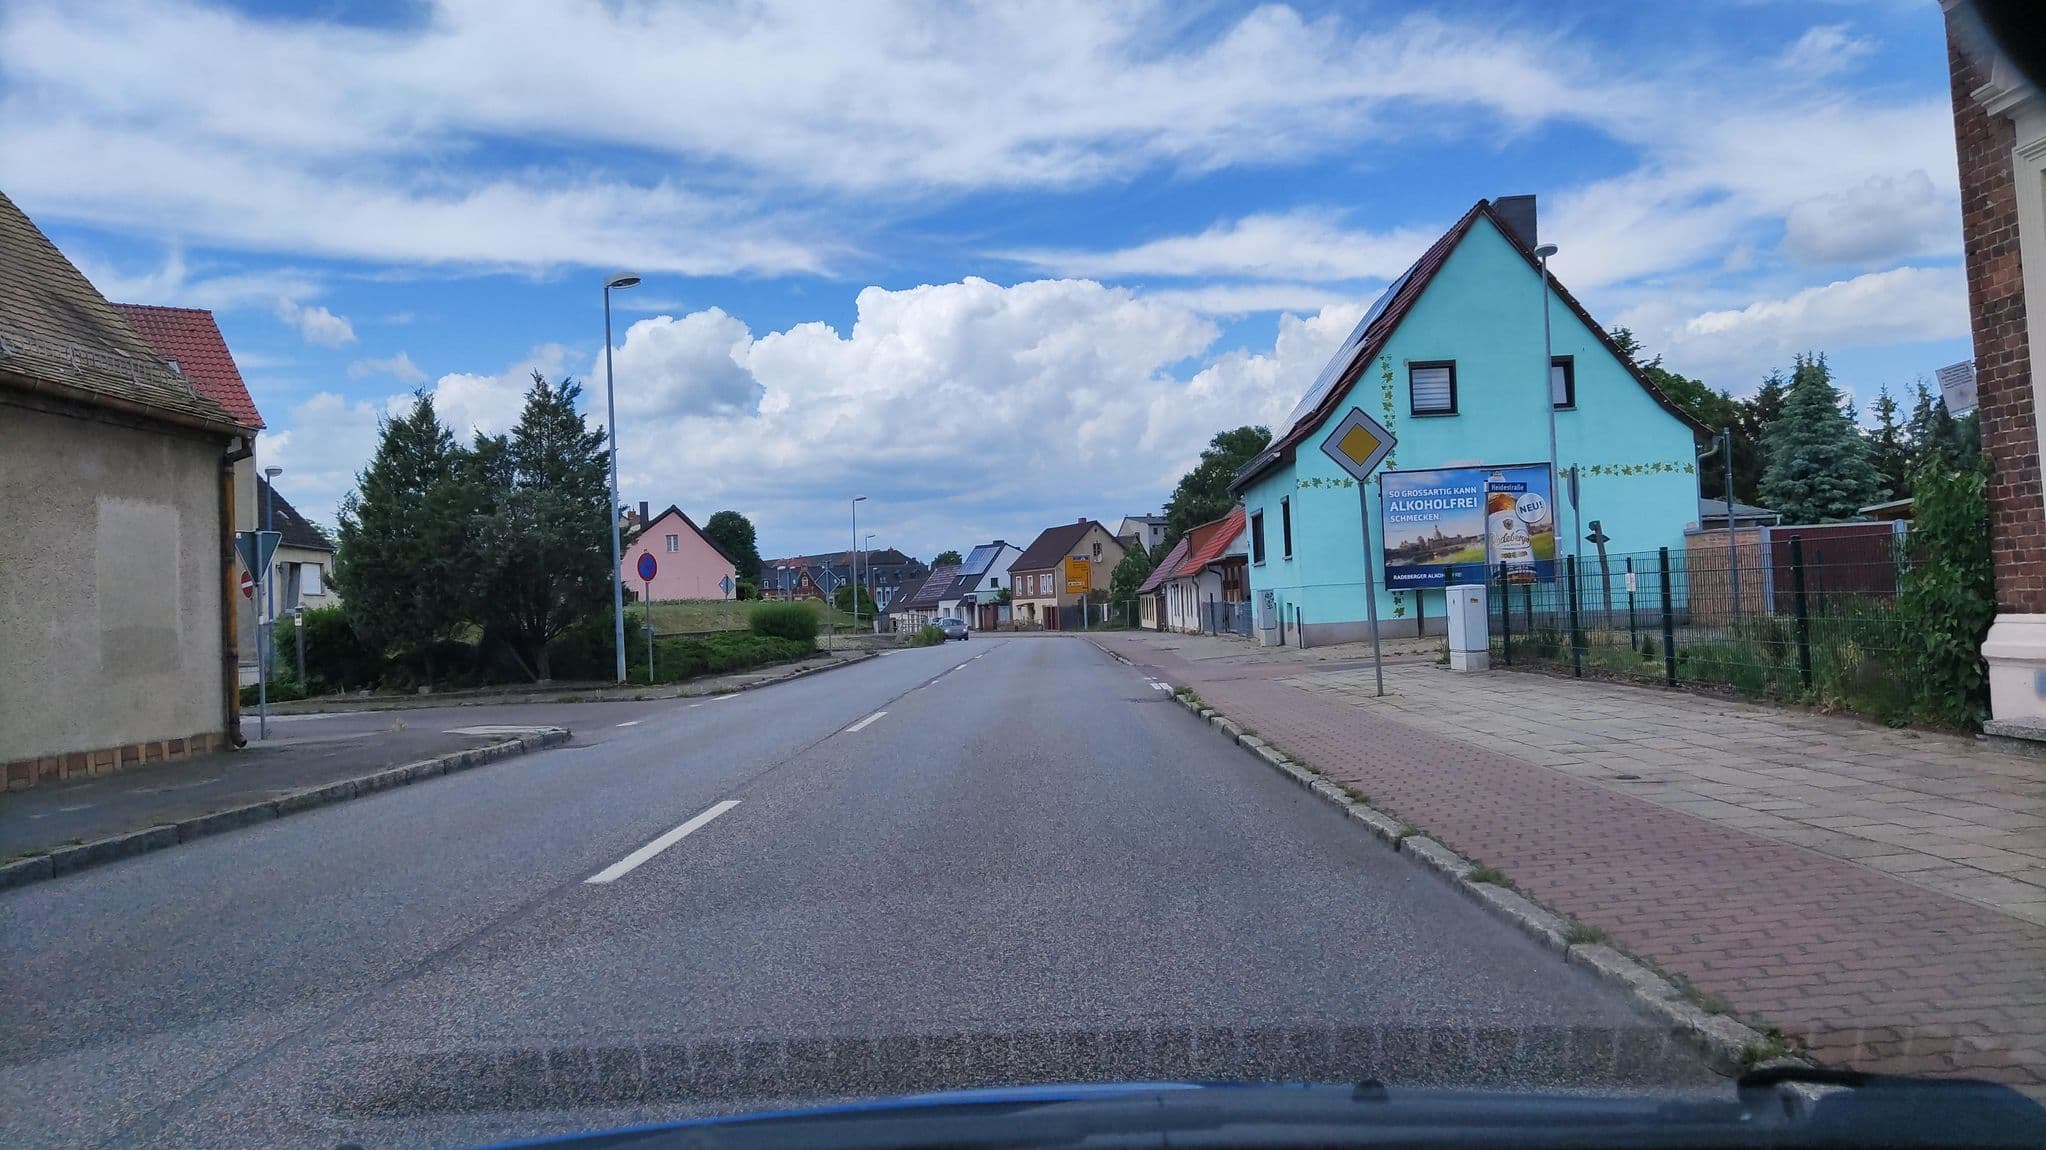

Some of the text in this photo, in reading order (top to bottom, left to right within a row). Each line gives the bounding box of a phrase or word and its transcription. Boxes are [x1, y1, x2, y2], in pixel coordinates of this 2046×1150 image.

[1389, 486, 1477, 498] SO GROSSARTIG KANN
[1491, 483, 1524, 491] Heidestraße
[1390, 497, 1478, 512] ALKOHOLFREI
[1519, 500, 1543, 514] NEU!
